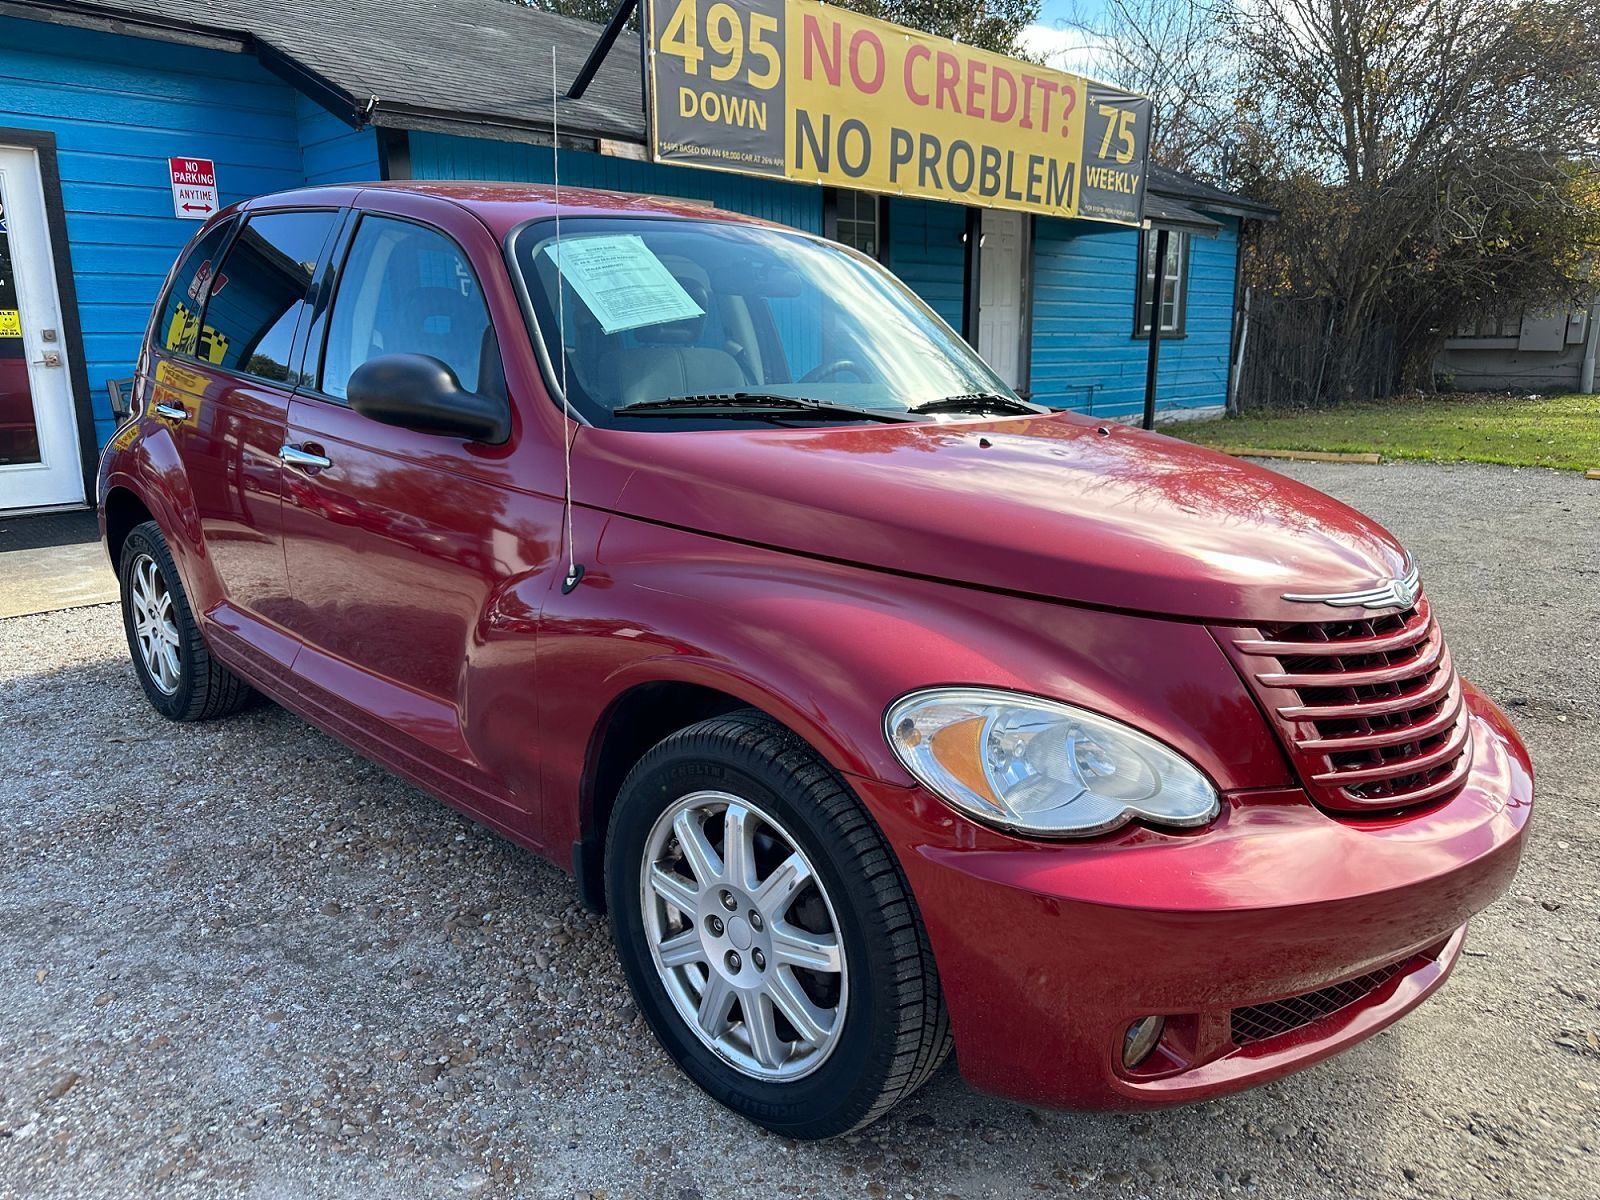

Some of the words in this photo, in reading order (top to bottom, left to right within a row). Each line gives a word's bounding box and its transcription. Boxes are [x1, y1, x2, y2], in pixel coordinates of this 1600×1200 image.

[659, 0, 781, 90] 495
[803, 14, 886, 95] NO
[903, 44, 1077, 139] CREDIT?
[679, 86, 767, 131] DOWN
[185, 161, 199, 172] NO
[679, 144, 700, 155] BASED
[700, 147, 711, 157] ON
[741, 153, 753, 162] CAR
[795, 108, 872, 178] NO
[889, 127, 1076, 209] PROBLEM
[173, 171, 214, 185] PARKING
[1086, 164, 1140, 195] WEEKLY
[179, 188, 213, 201] ANYTIME
